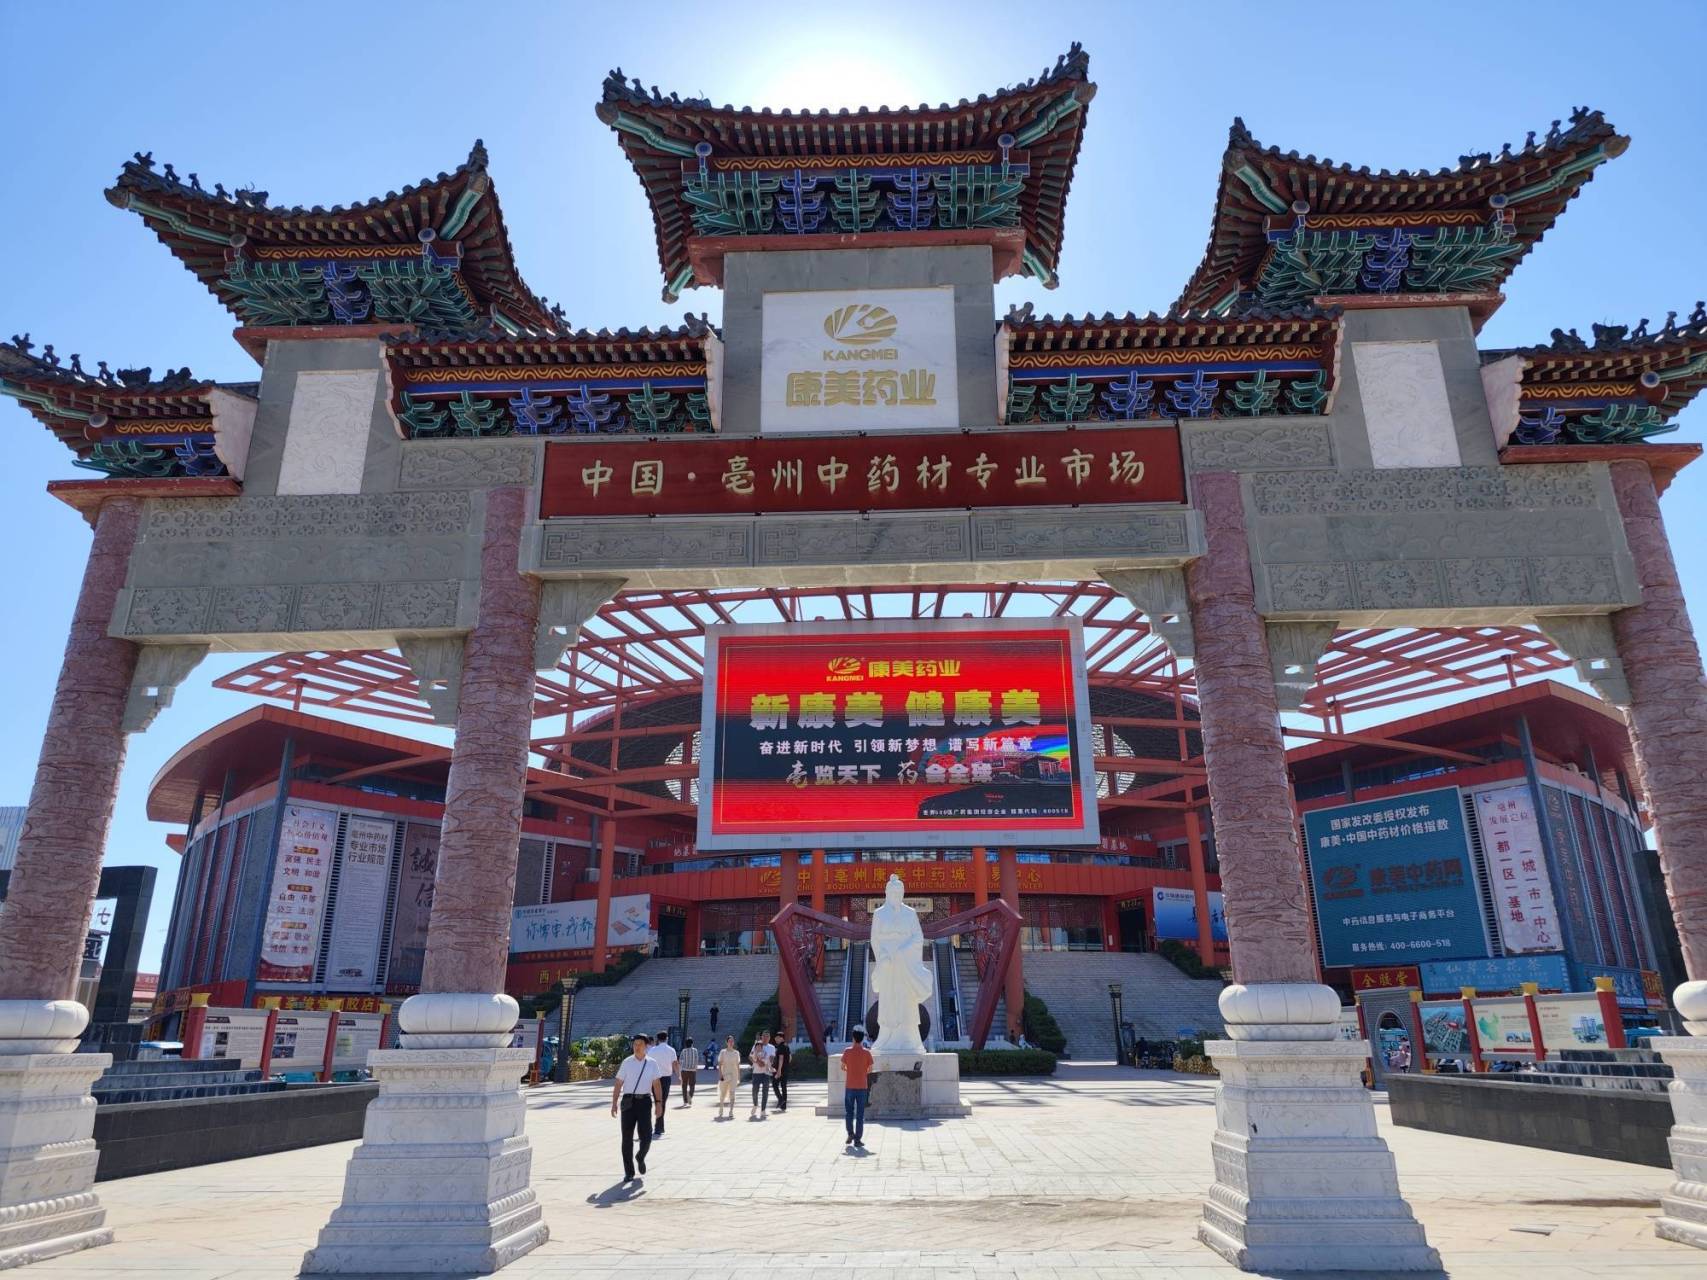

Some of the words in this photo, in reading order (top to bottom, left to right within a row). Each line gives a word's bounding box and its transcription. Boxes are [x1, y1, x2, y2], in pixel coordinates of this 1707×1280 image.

[823, 349, 898, 361] KANGMEI
[785, 369, 936, 407] 康美药业
[581, 449, 1146, 497] 中国·亳州中药材专业市场
[868, 660, 961, 677] 康美药业
[750, 692, 884, 730] 新康美
[905, 689, 1041, 727] 健康美
[759, 740, 843, 755] 奋进新时代
[853, 738, 937, 753] 引领新梦想
[948, 736, 1034, 751] 谱写新篇章
[1330, 804, 1430, 831] 国家发改委授权发布
[1489, 811, 1530, 825] 发展定位
[1320, 818, 1449, 848] 康美·中国中药材价格指数
